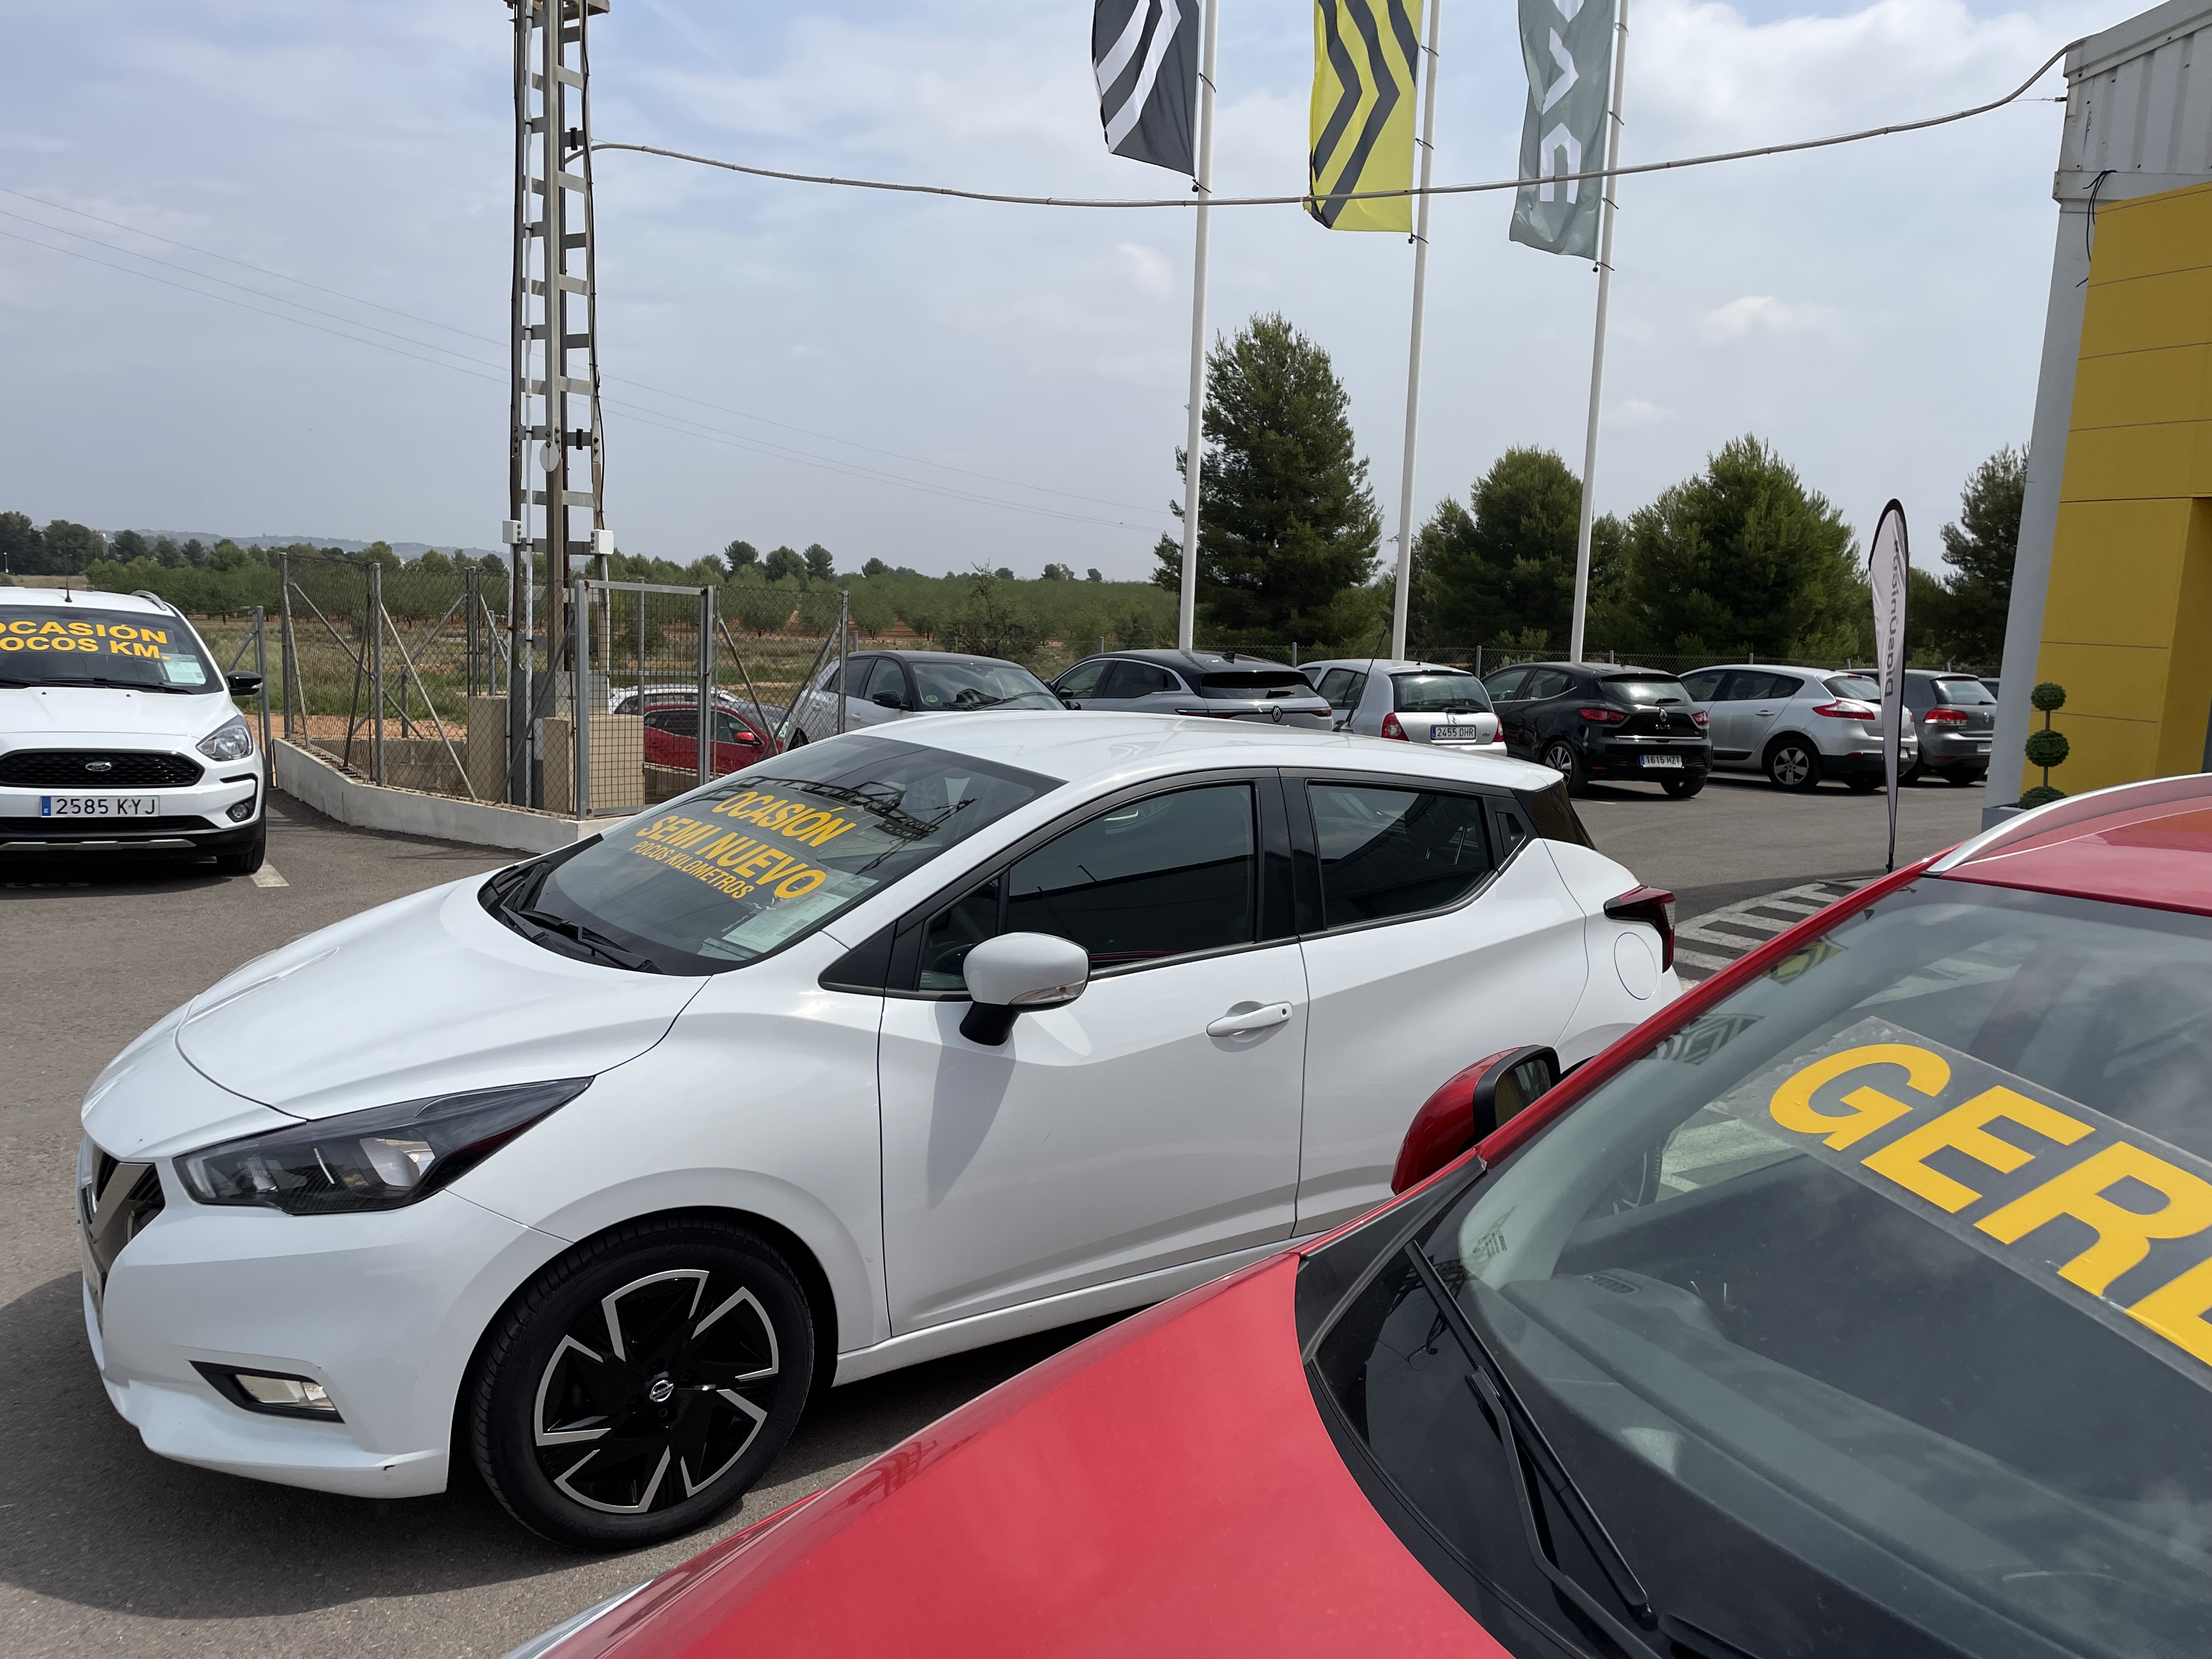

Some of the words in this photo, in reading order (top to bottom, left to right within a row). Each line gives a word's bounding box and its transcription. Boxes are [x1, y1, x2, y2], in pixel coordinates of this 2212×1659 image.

[0, 620, 167, 644] CASIÓN
[0, 636, 99, 652] OCOS
[110, 640, 170, 660] KM.
[1437, 728, 1457, 737] 2455
[1459, 728, 1474, 737] DHR
[1646, 756, 1665, 764] 1615
[1667, 756, 1680, 764] HZT
[56, 798, 109, 815] 2585
[117, 799, 155, 815] KYJ
[713, 791, 857, 848] OCASIÓN
[629, 840, 675, 861] POCOS
[636, 816, 723, 850] SEMI
[694, 832, 827, 899] NUEVO
